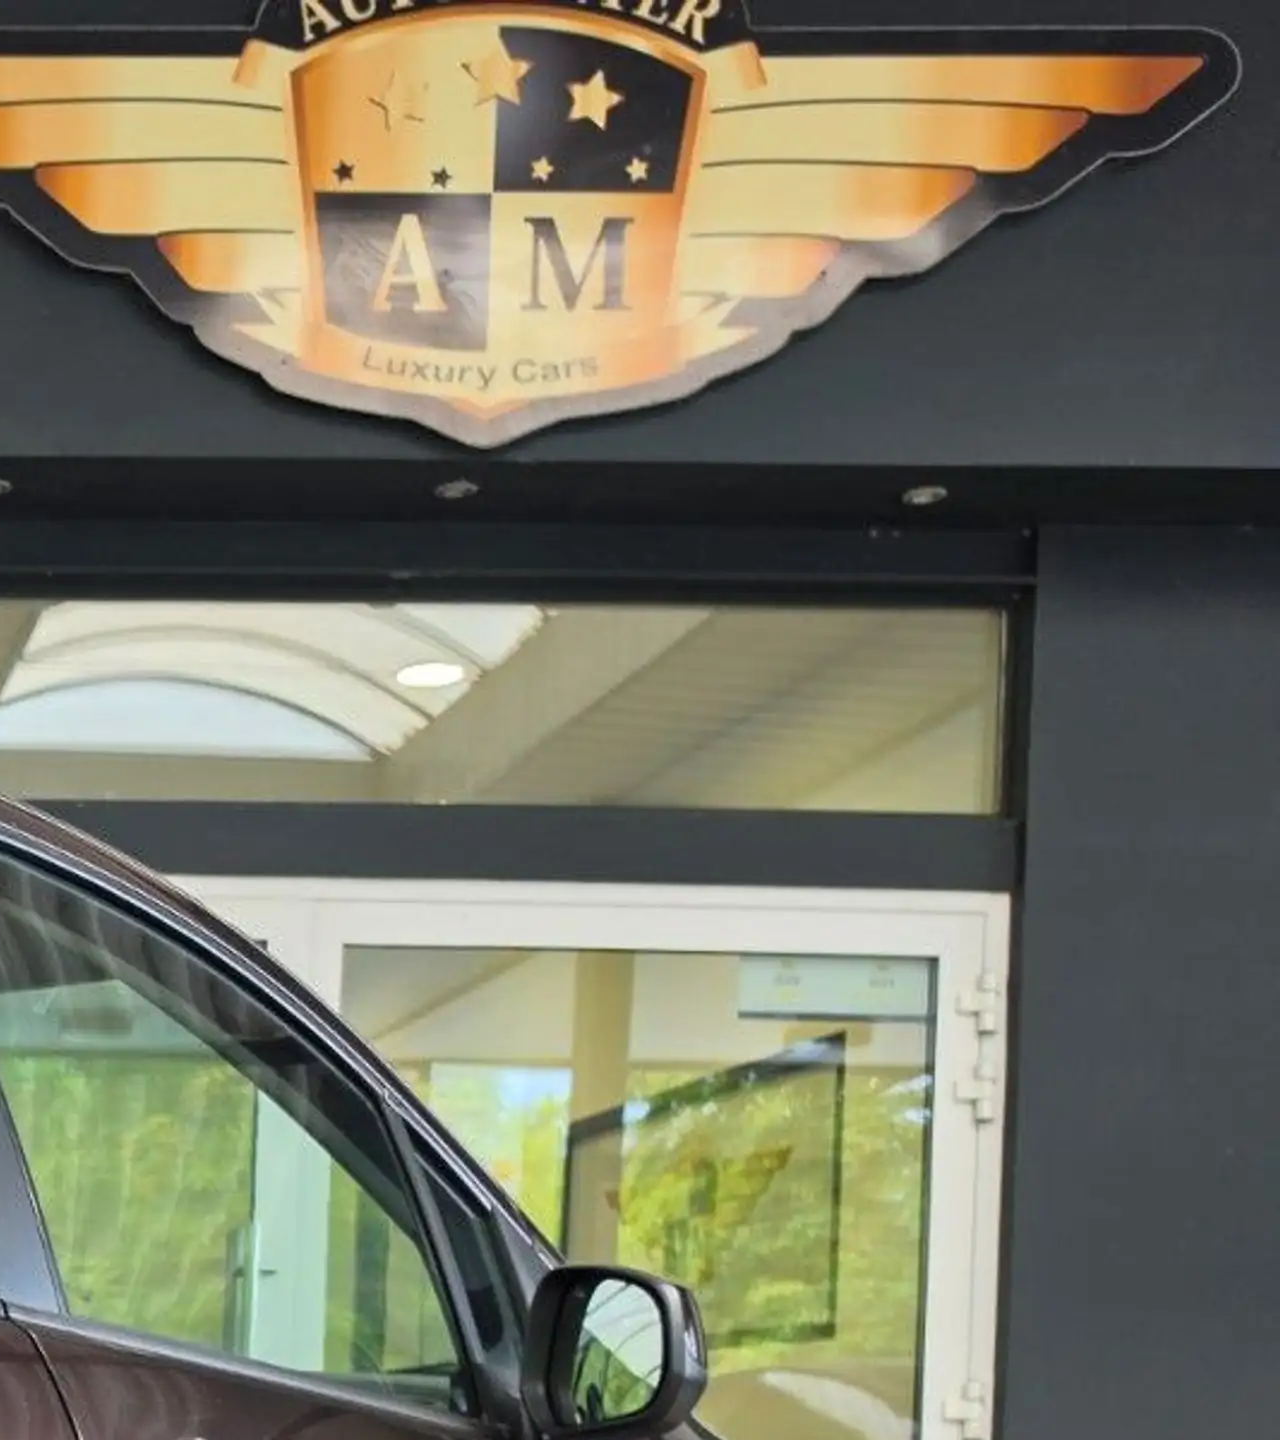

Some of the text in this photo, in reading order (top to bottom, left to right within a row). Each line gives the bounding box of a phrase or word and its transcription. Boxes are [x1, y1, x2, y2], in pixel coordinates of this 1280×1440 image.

[371, 213, 634, 312] A M
[362, 345, 599, 391] Luxury Cars
